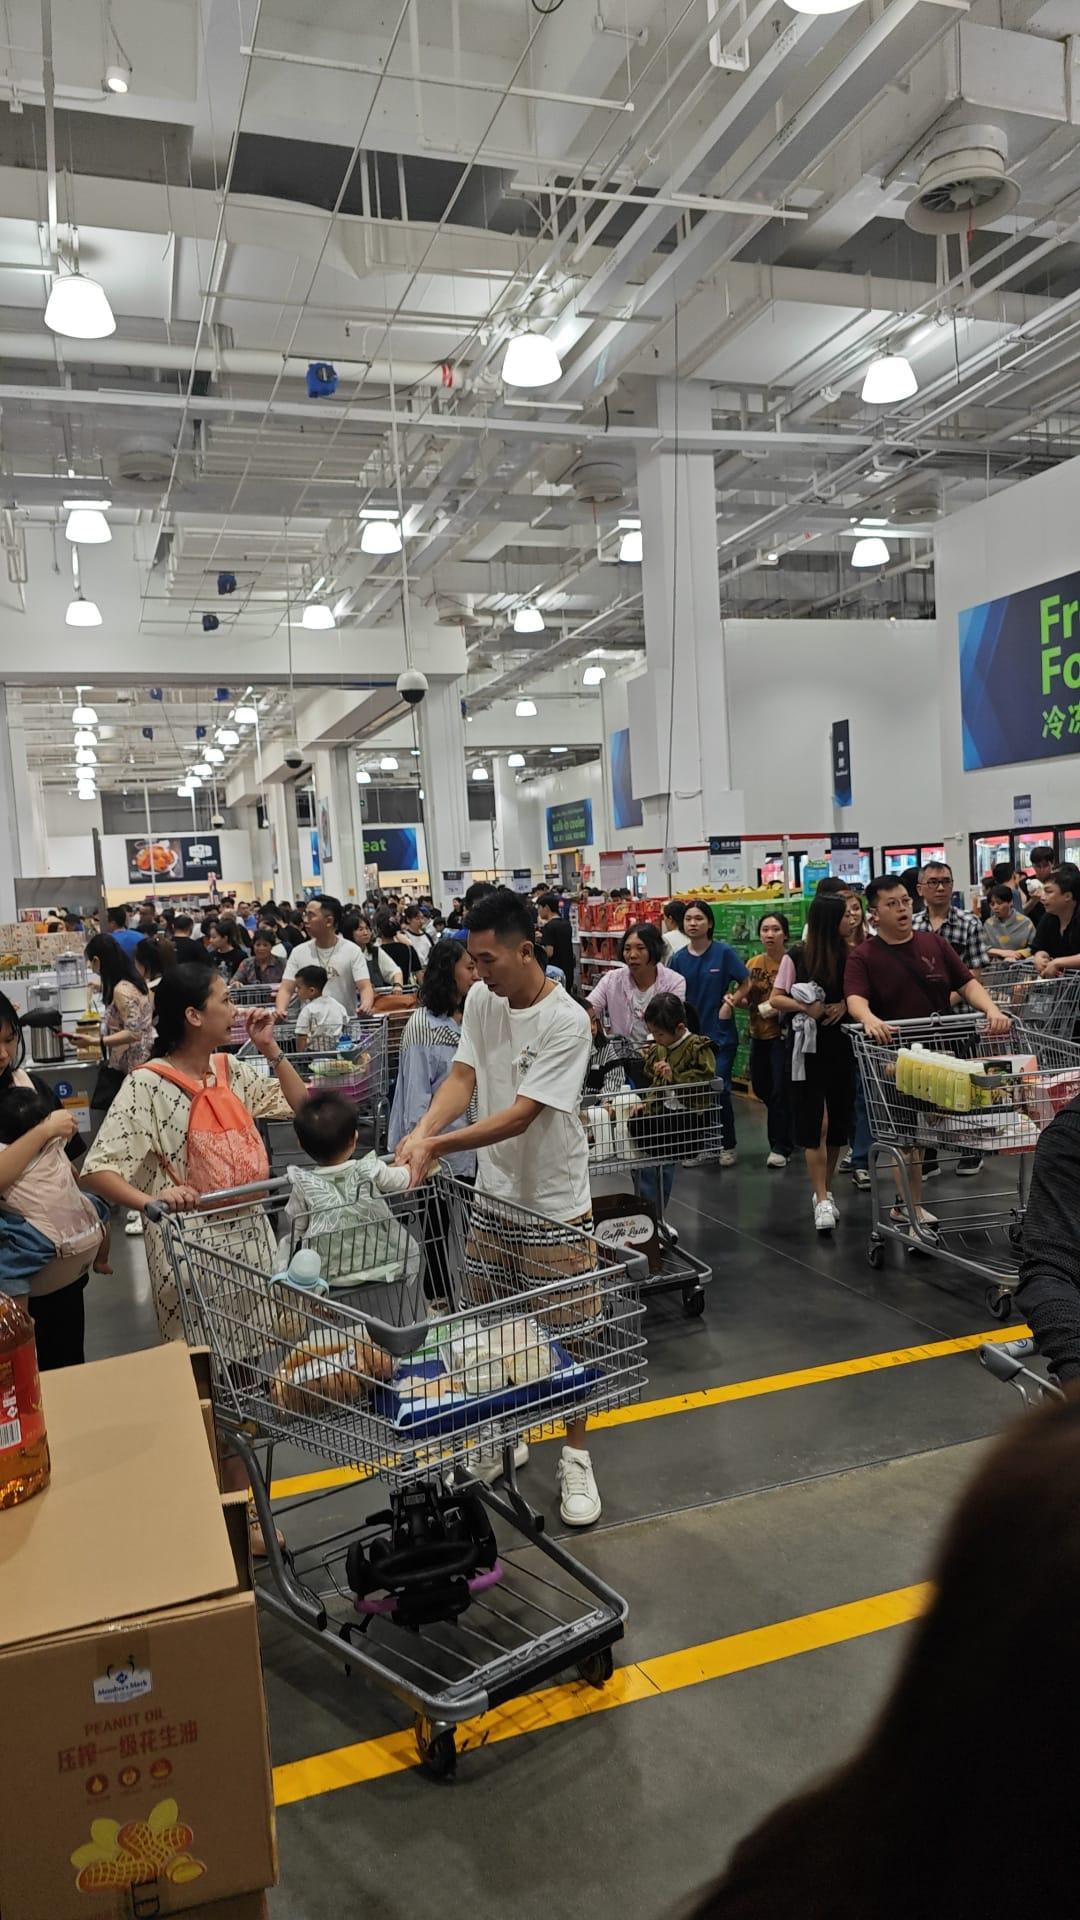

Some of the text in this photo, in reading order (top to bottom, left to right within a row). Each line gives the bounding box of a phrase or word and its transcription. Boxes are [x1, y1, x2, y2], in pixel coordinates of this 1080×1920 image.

[58, 1084, 68, 1096] 5
[628, 1226, 649, 1238] Latte
[84, 1706, 165, 1737] PEANUT OIL
[57, 1718, 199, 1775] 压榨一级花生油
